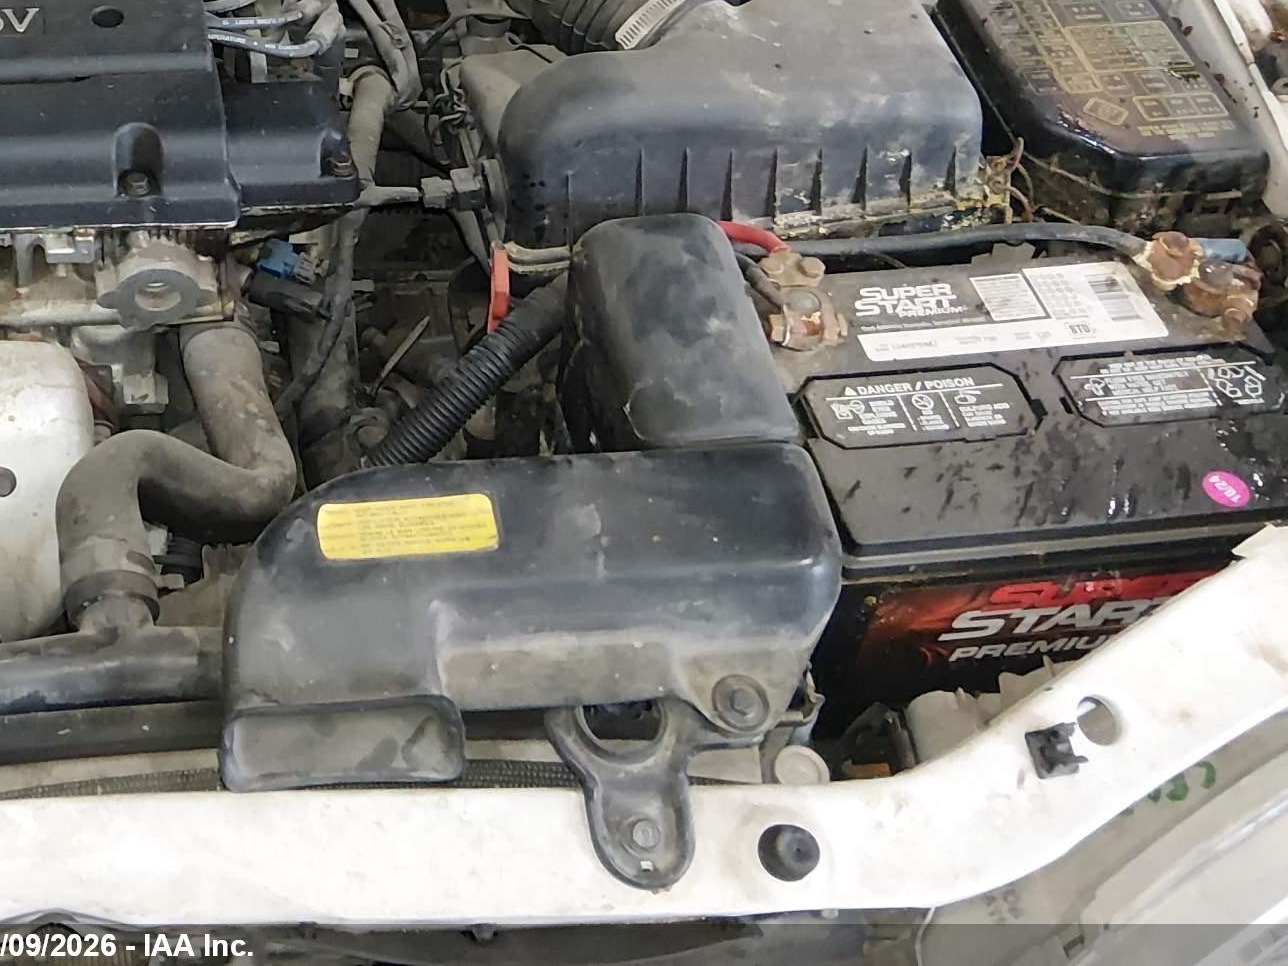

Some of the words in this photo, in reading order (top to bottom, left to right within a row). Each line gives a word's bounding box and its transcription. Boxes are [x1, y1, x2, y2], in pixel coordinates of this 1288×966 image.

[859, 283, 957, 303] SUPER
[854, 297, 951, 317] START
[856, 381, 913, 395] DANGER
[924, 377, 975, 390] POISON
